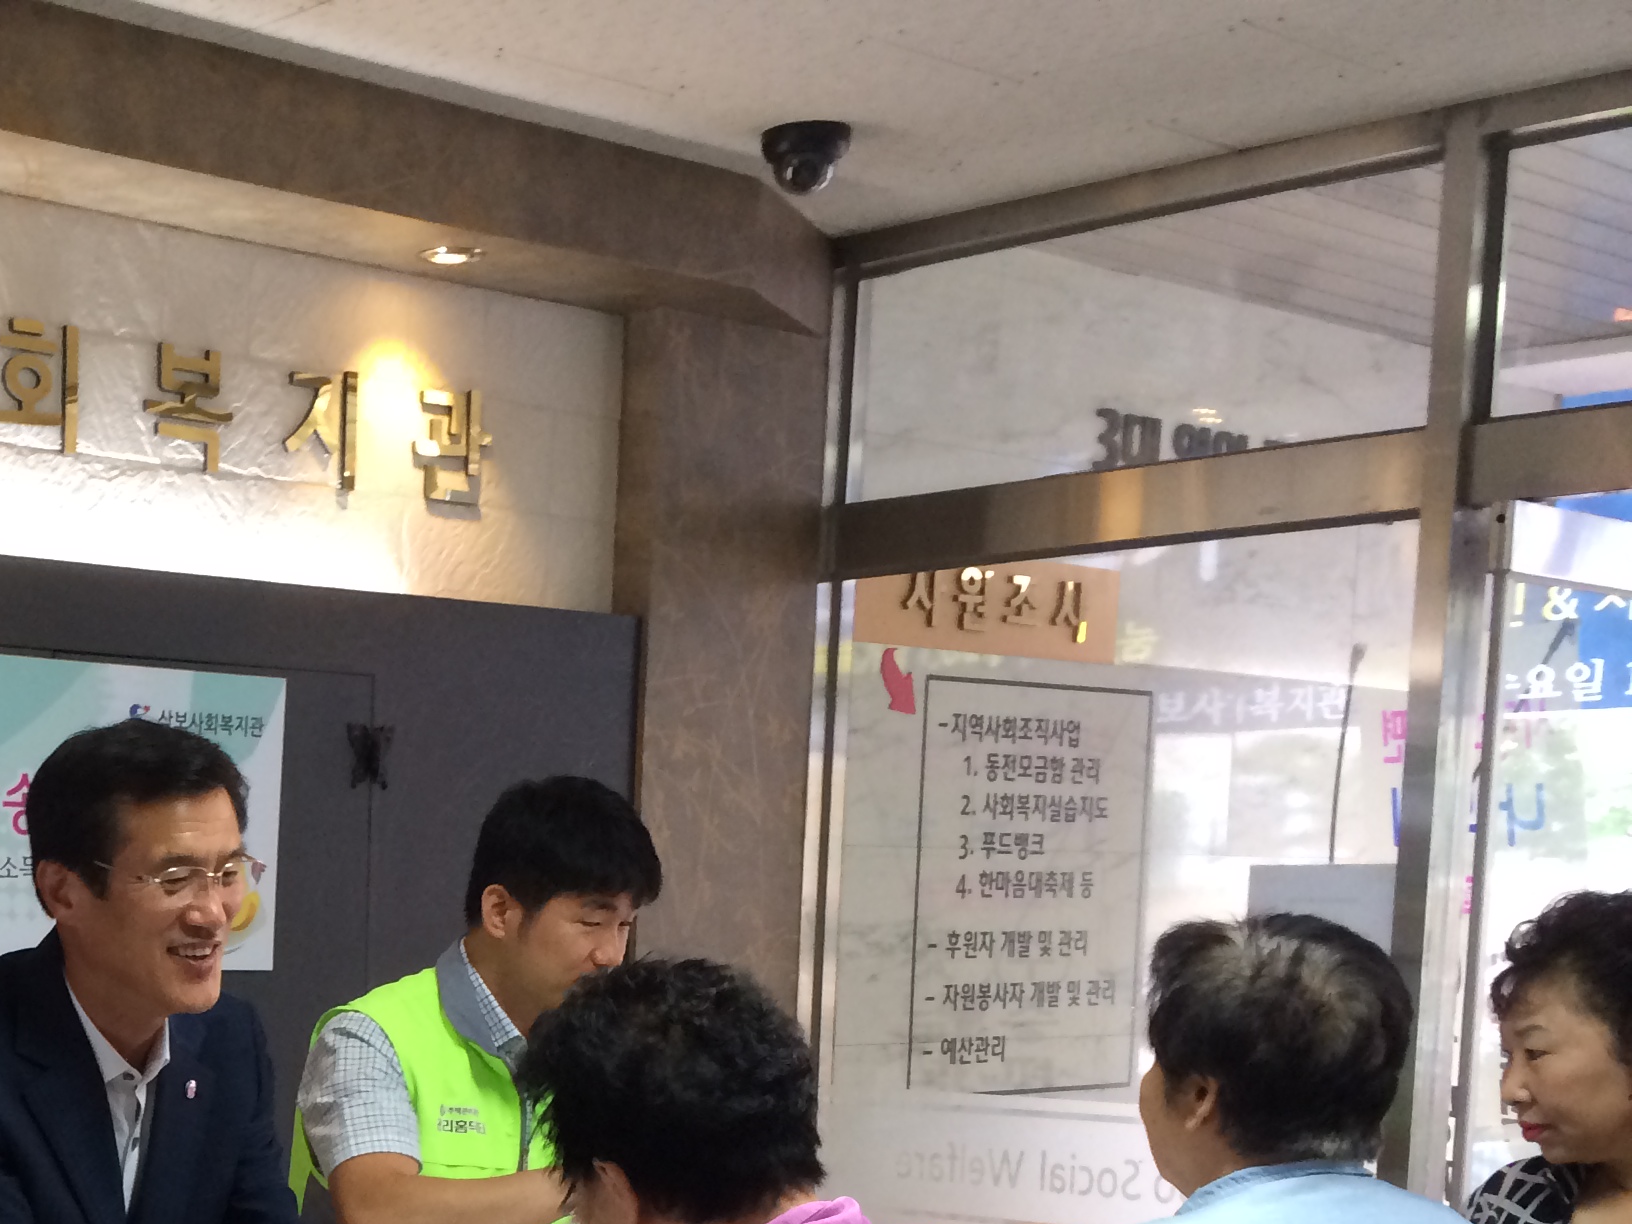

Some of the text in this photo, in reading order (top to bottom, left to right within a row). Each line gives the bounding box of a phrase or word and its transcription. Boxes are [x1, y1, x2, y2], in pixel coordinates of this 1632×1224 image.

[1505, 658, 1604, 702] 요일
[985, 753, 1065, 784] 동전모금함
[1070, 757, 1101, 785] 관리
[2, 773, 33, 836] 송
[983, 792, 1109, 823] 사회복지실습지도
[980, 831, 1045, 861] 푸드뱅크
[978, 870, 1074, 899] 한마음대축제
[1079, 871, 1094, 899] 등
[945, 930, 995, 959] 후원자
[1001, 930, 1033, 959] 개발
[1037, 930, 1052, 957] 및
[1058, 930, 1088, 957] 관리
[942, 982, 1025, 1011] 자원봉사자
[1030, 981, 1061, 1008] 개발
[1066, 980, 1081, 1006] 및
[1086, 979, 1116, 1006] 관리
[940, 1035, 1006, 1065] 예산관리
